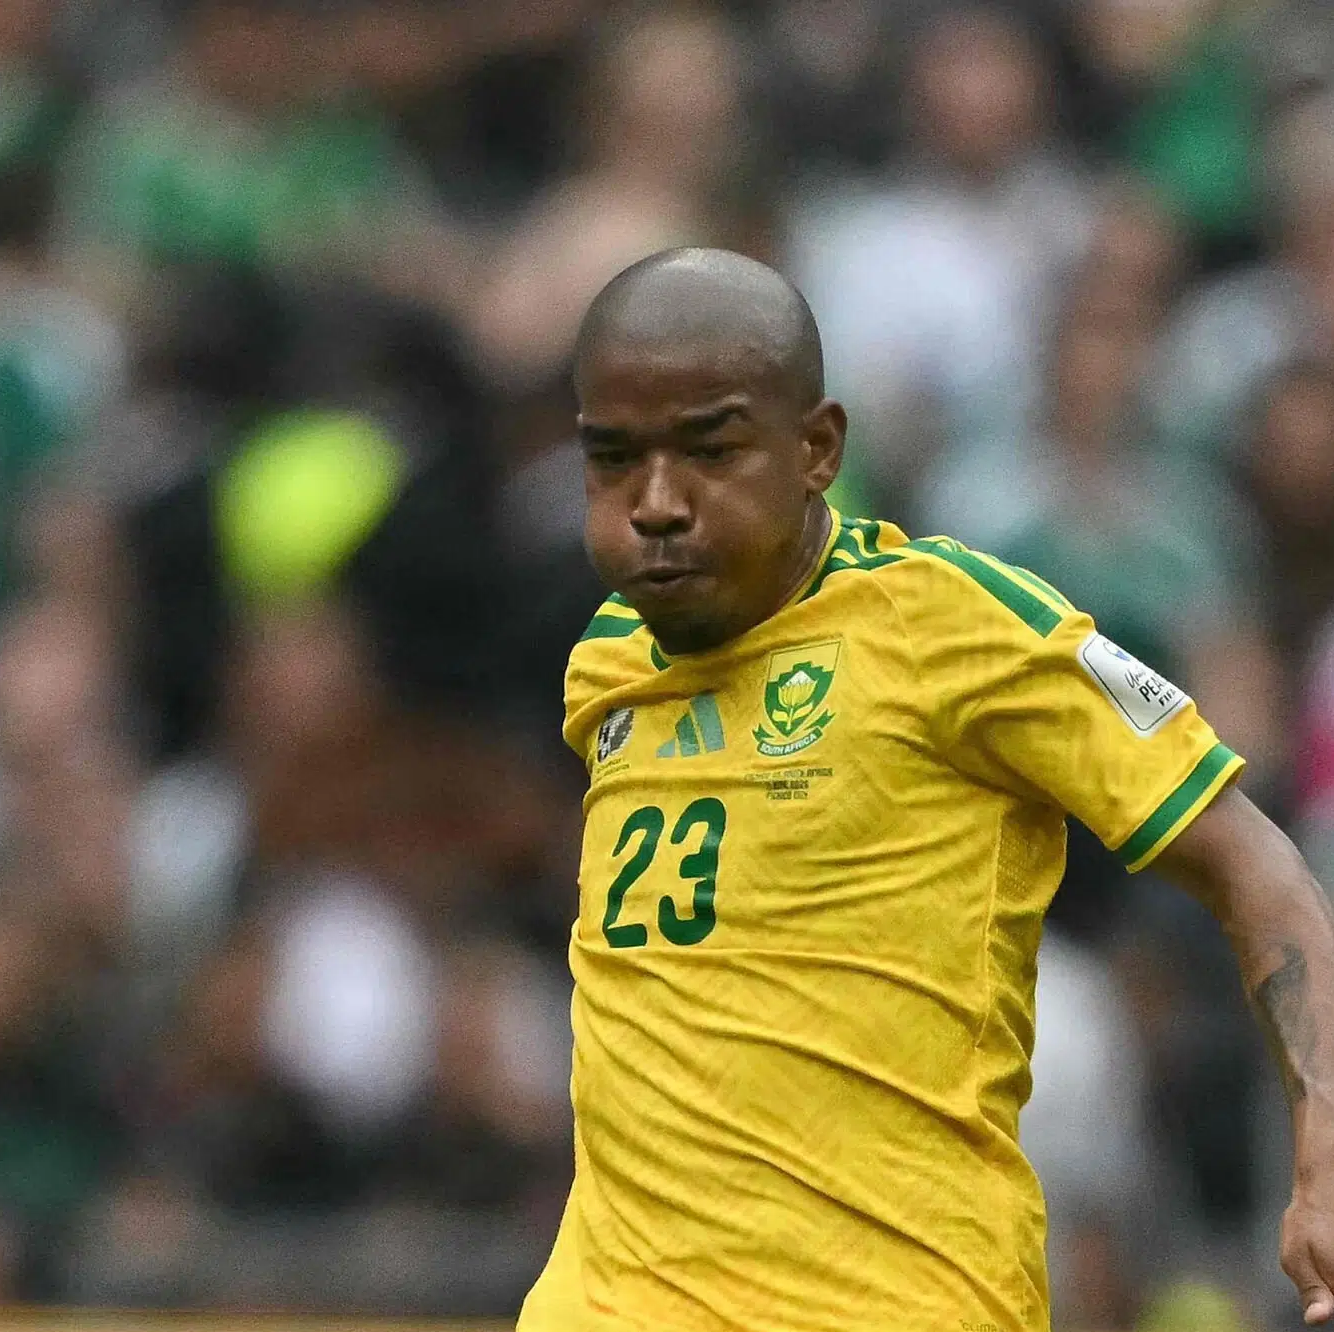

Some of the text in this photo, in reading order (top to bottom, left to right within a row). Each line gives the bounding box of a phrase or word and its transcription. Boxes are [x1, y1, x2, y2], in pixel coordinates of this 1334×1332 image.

[1138, 676, 1167, 703] PEA
[760, 733, 817, 755] SOUTH AFRICA
[602, 797, 727, 948] 23
